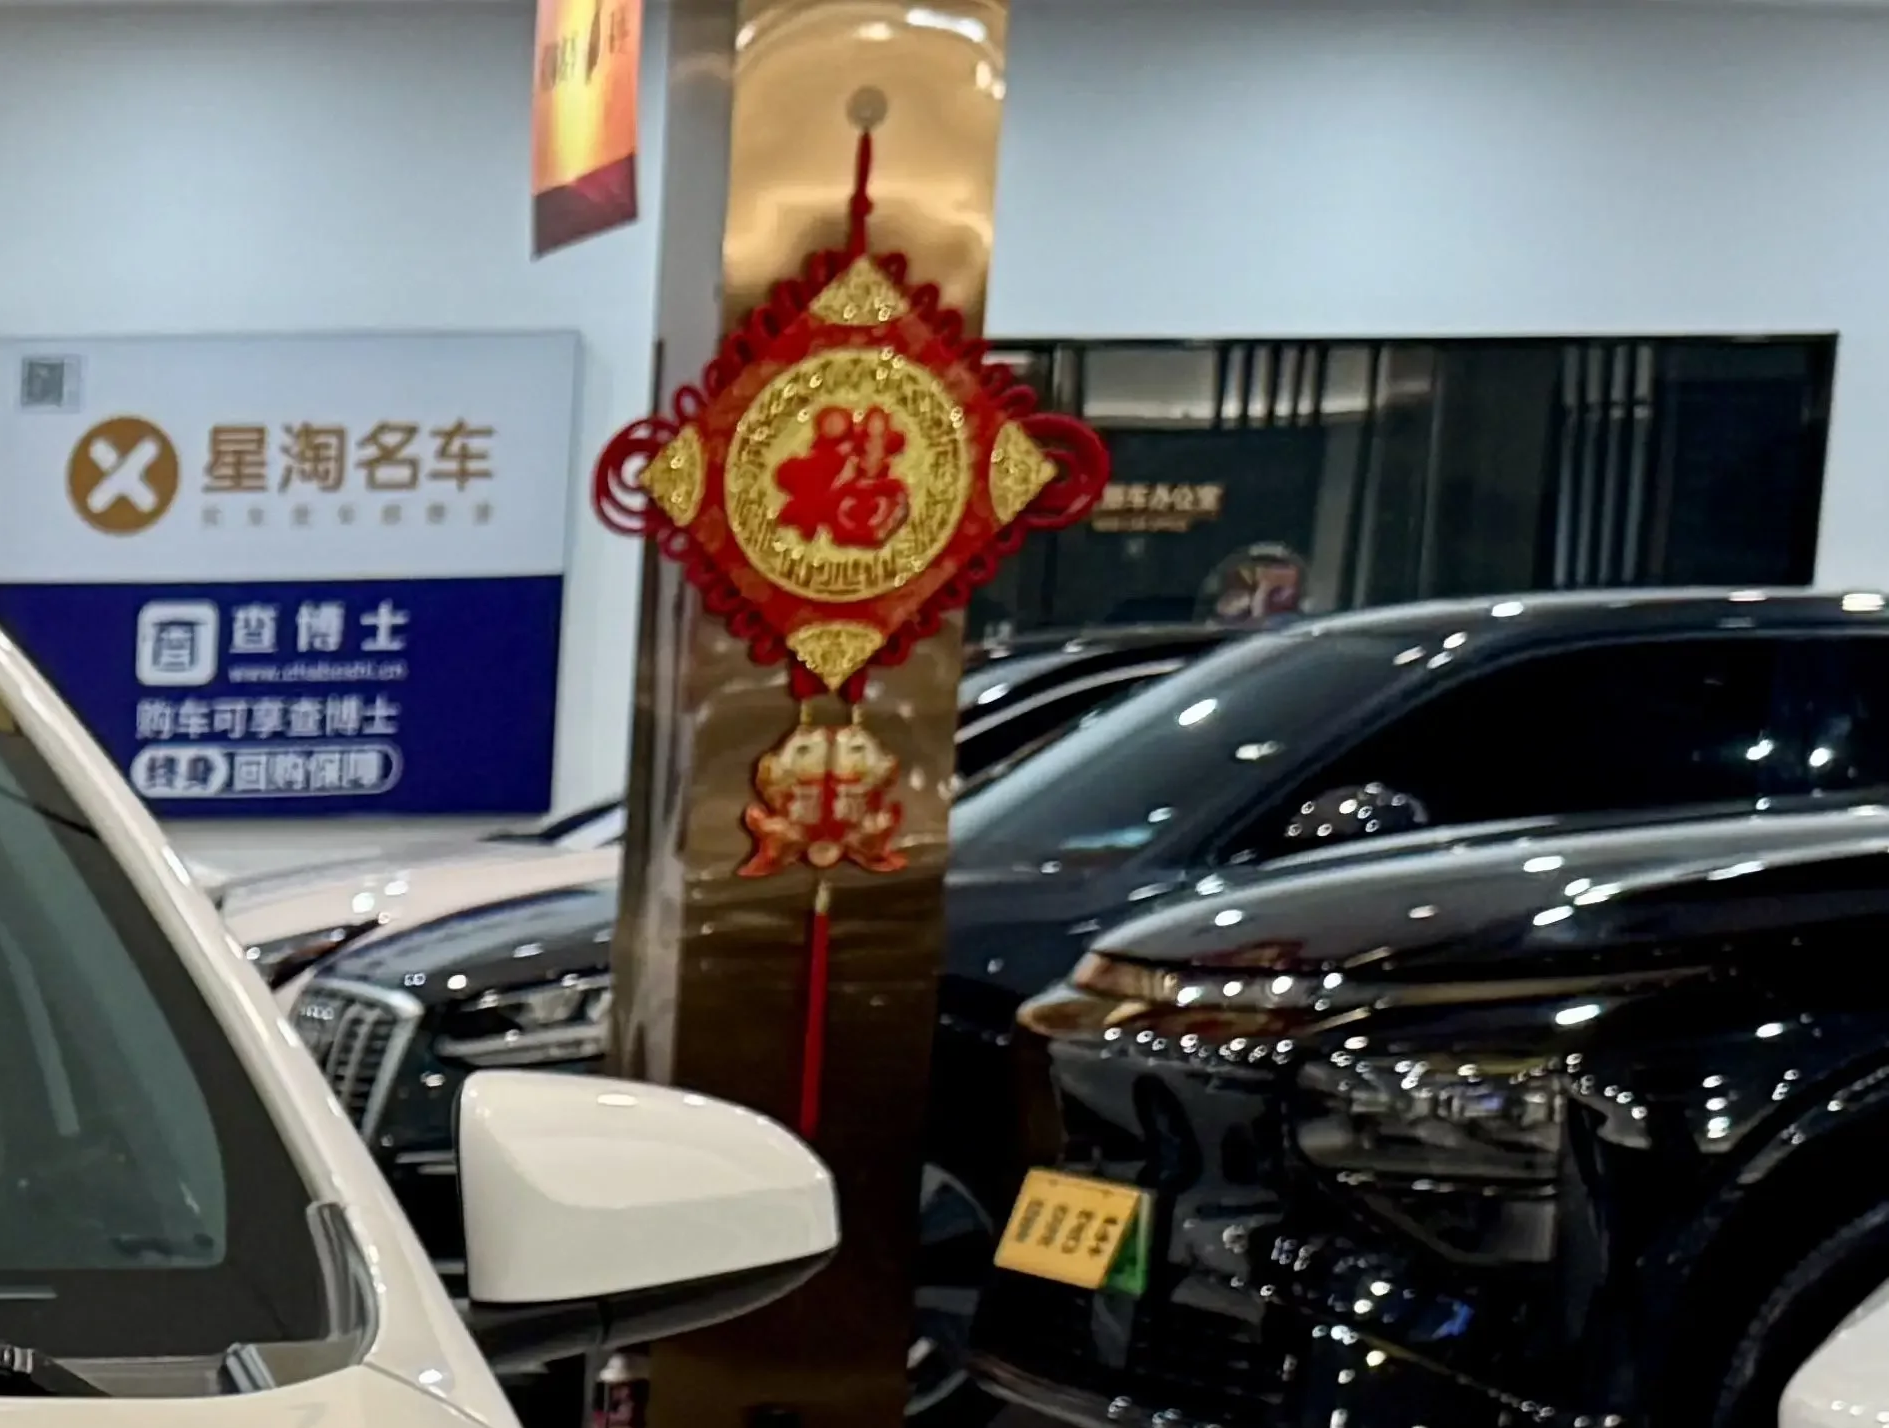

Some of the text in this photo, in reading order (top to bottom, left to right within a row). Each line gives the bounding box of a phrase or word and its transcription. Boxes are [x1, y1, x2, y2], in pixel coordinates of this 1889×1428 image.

[201, 417, 497, 494] 星淘名车
[229, 599, 410, 654] 查博士
[135, 693, 400, 740] 购车可享查博士
